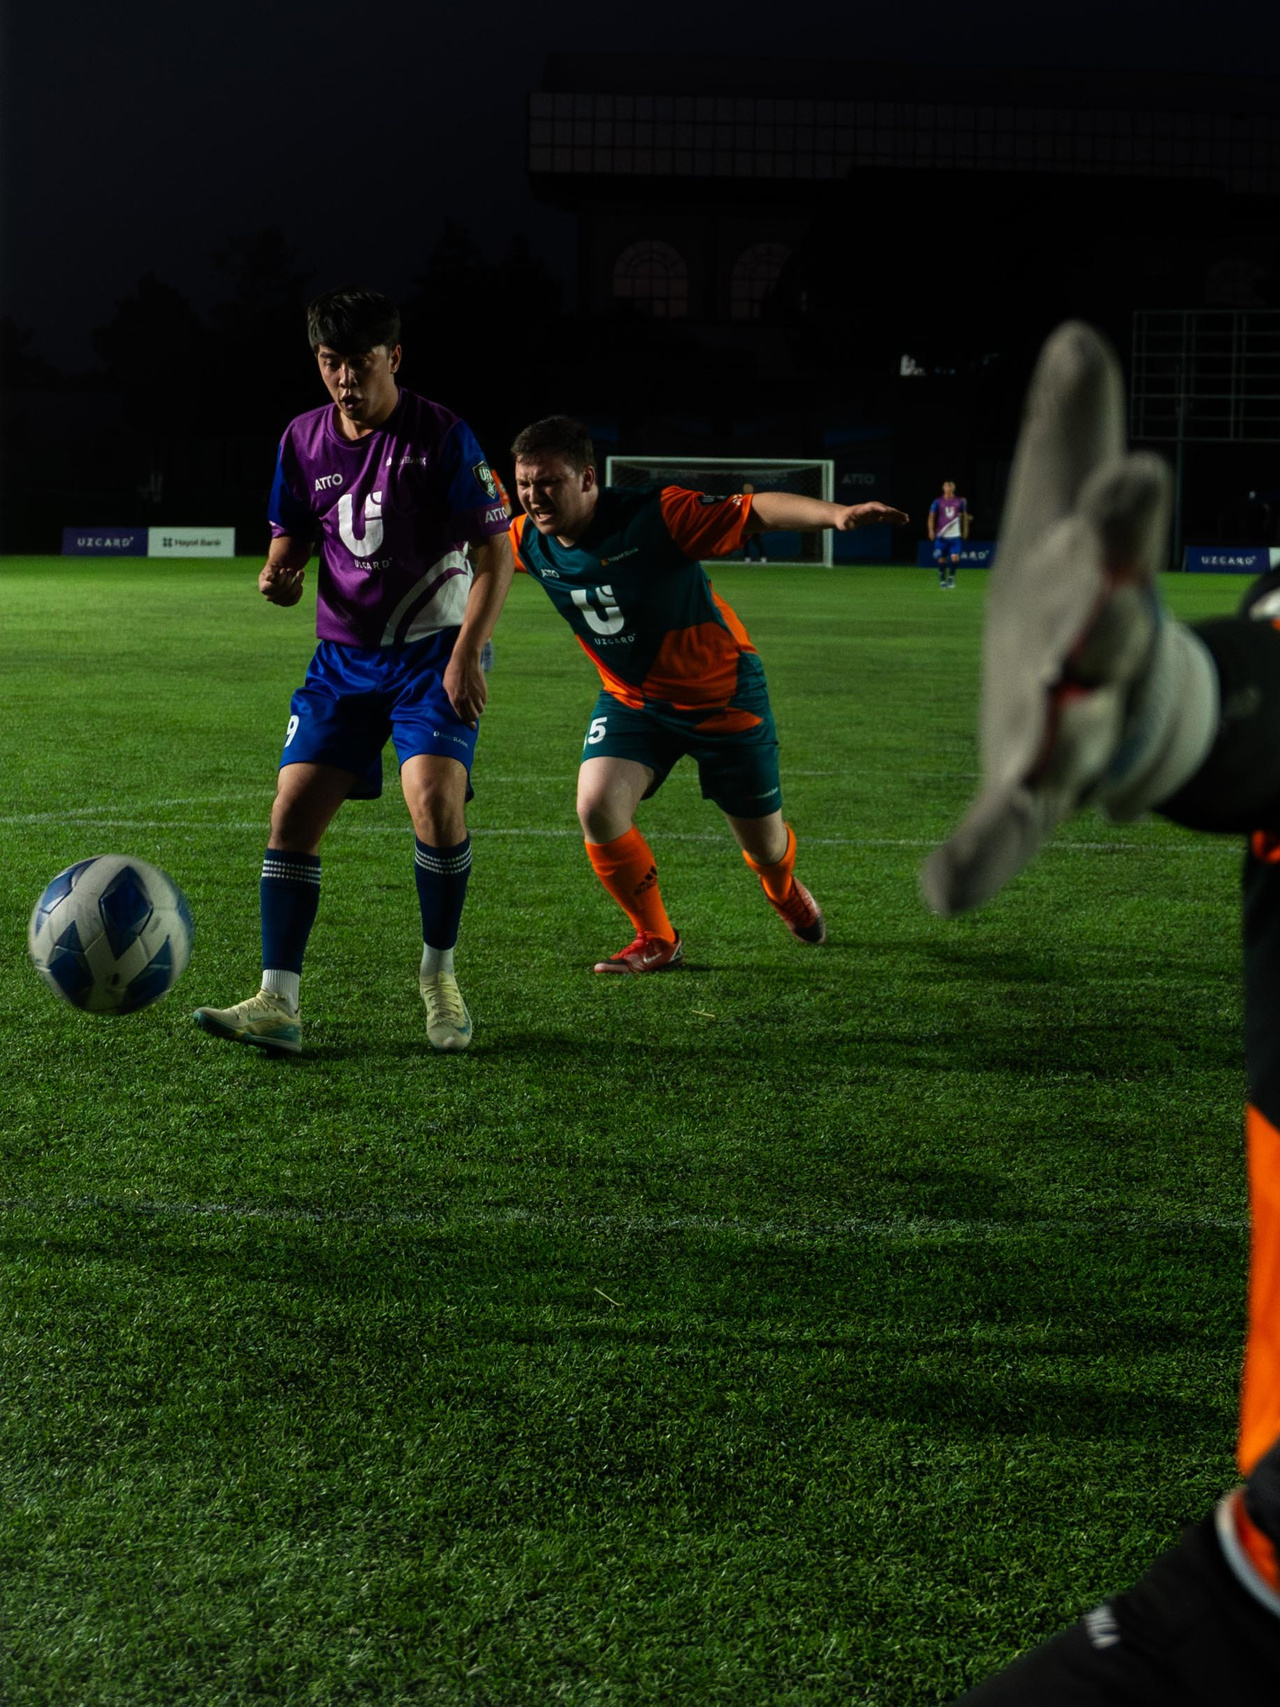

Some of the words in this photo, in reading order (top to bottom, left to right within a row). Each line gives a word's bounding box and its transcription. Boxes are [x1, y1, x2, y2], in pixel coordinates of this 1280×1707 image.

[314, 473, 343, 492] ATTO
[77, 537, 134, 547] UZCARD
[1201, 555, 1256, 566] UZCARD
[594, 634, 636, 646] UZCARD
[583, 716, 608, 749] 5
